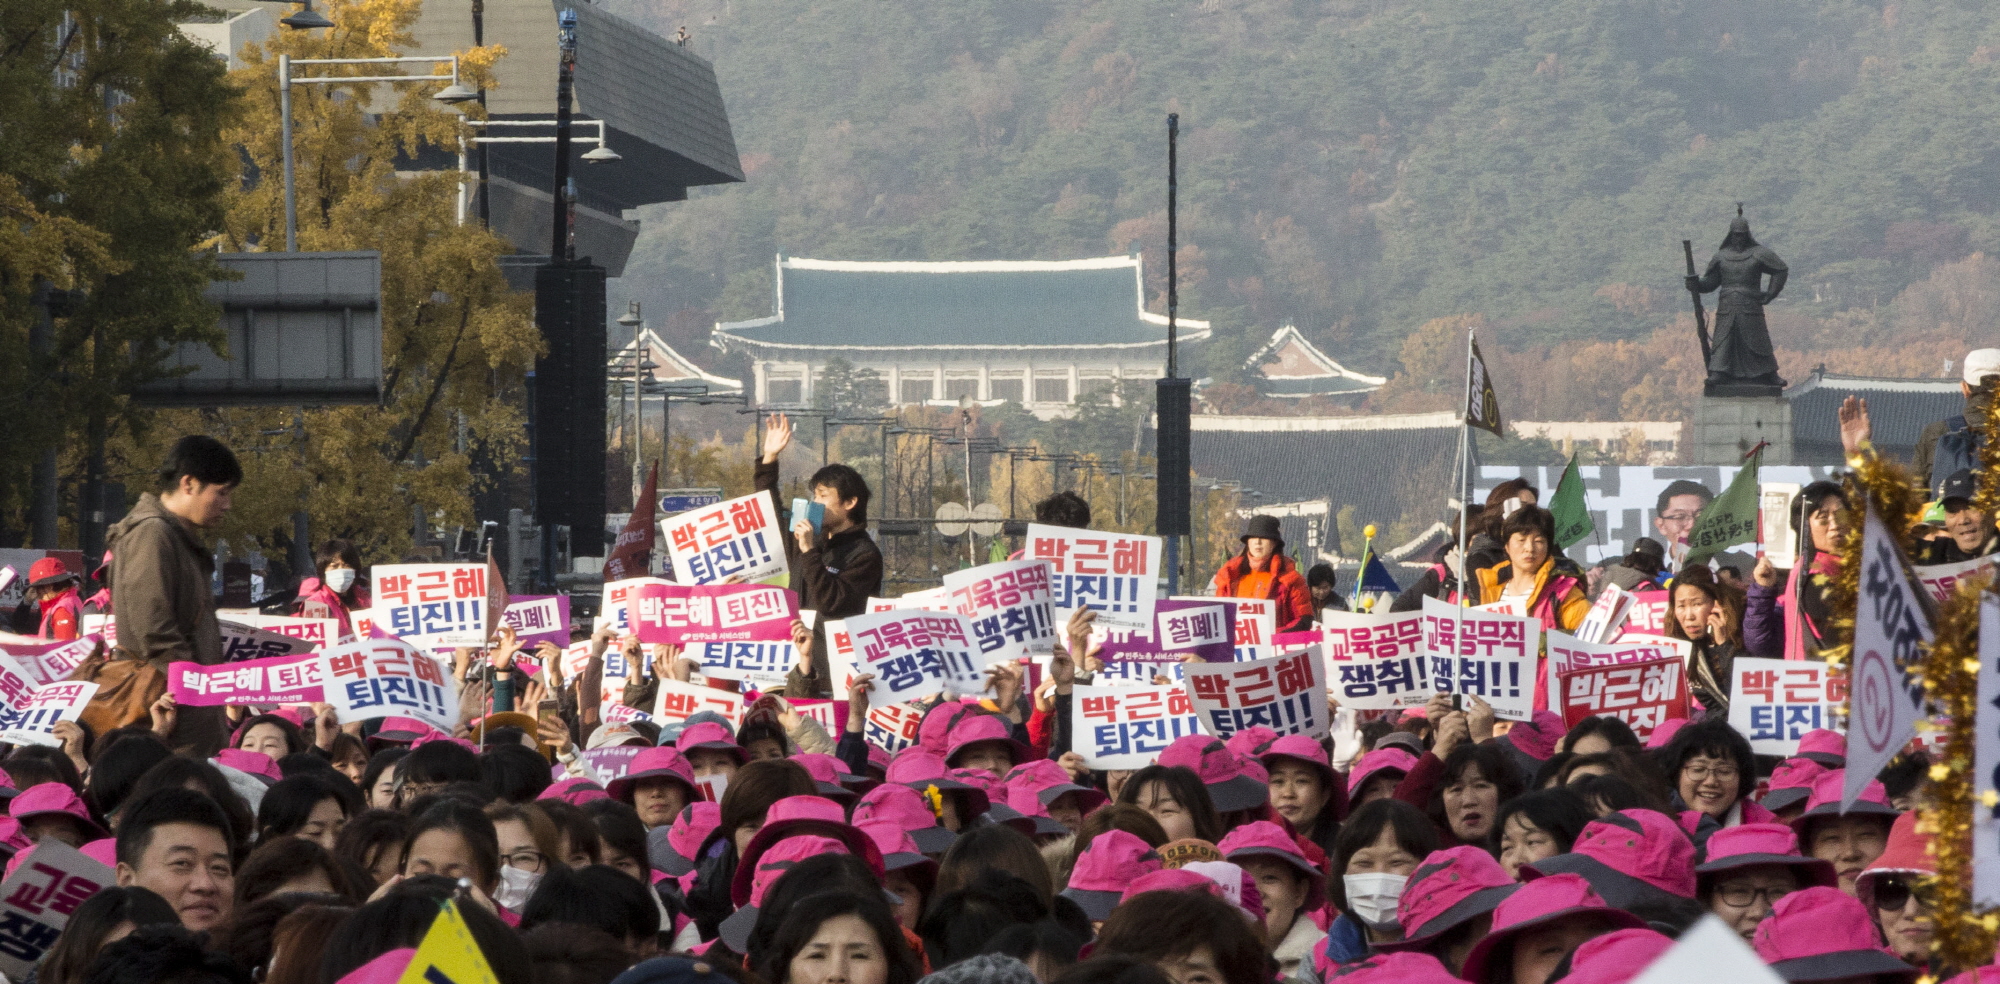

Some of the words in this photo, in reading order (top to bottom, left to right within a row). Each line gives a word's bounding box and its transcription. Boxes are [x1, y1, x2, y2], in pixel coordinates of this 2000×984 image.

[671, 497, 767, 553] 박근혜
[687, 532, 772, 586] 퇴진!!
[1034, 537, 1148, 576] 박근혜
[379, 567, 487, 605] 박근혜
[951, 563, 1050, 619] 교육공무직
[390, 600, 482, 638] 퇴진!!
[639, 595, 714, 628] 박근혜
[727, 591, 782, 623] 퇴진!
[971, 602, 1054, 654] 쟁취!!
[1167, 612, 1220, 644] 철폐!
[691, 632, 718, 641] 민주노총
[701, 641, 793, 672] 퇴진!!
[856, 616, 970, 663] 교육공무직
[1125, 651, 1153, 661] 민주노총
[1330, 616, 1424, 661] 교육공무
[1425, 614, 1525, 657] 교육공무직
[182, 666, 264, 696] 박근혜
[329, 646, 445, 688] 박근혜
[876, 648, 981, 693] 쟁취!!
[1190, 652, 1316, 710] 박근혜
[1430, 655, 1520, 698] 쟁취!!
[1568, 662, 1681, 711] 박근혜
[345, 676, 447, 717] 퇴진!!
[1209, 692, 1315, 742] 퇴진!!
[1094, 716, 1199, 759] 퇴진!!
